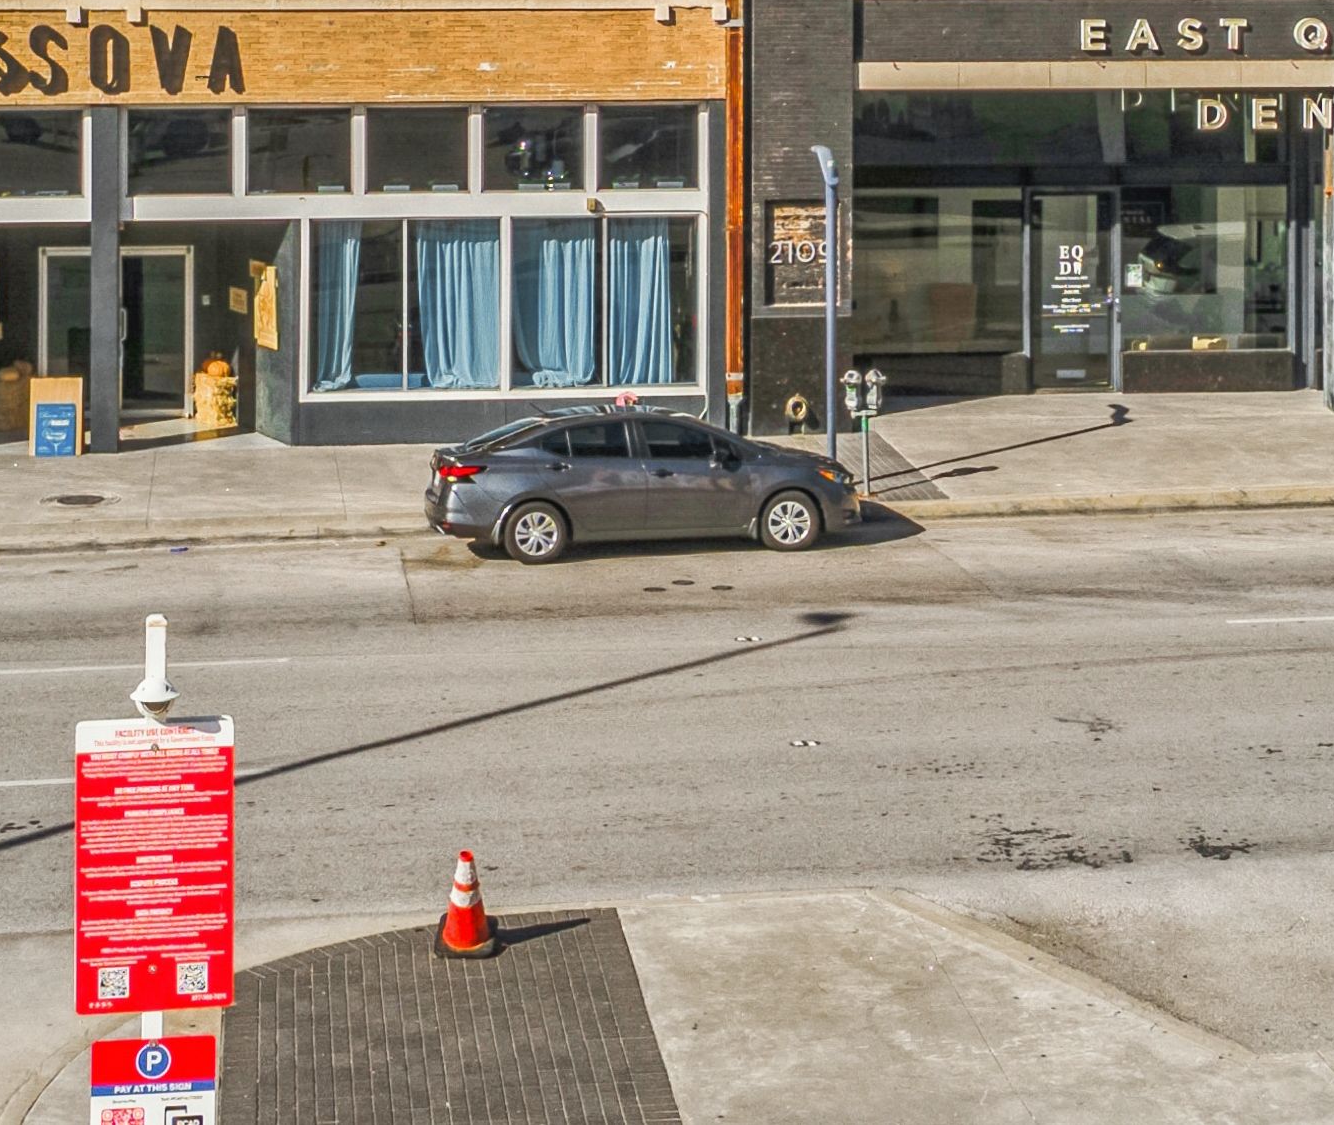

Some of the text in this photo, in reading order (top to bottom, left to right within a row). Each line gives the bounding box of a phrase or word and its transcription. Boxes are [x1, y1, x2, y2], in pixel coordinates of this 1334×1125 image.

[1079, 17, 1248, 50] EAST
[146, 1051, 163, 1072] P
[114, 1082, 192, 1094] PAY AT THIS SIGN
